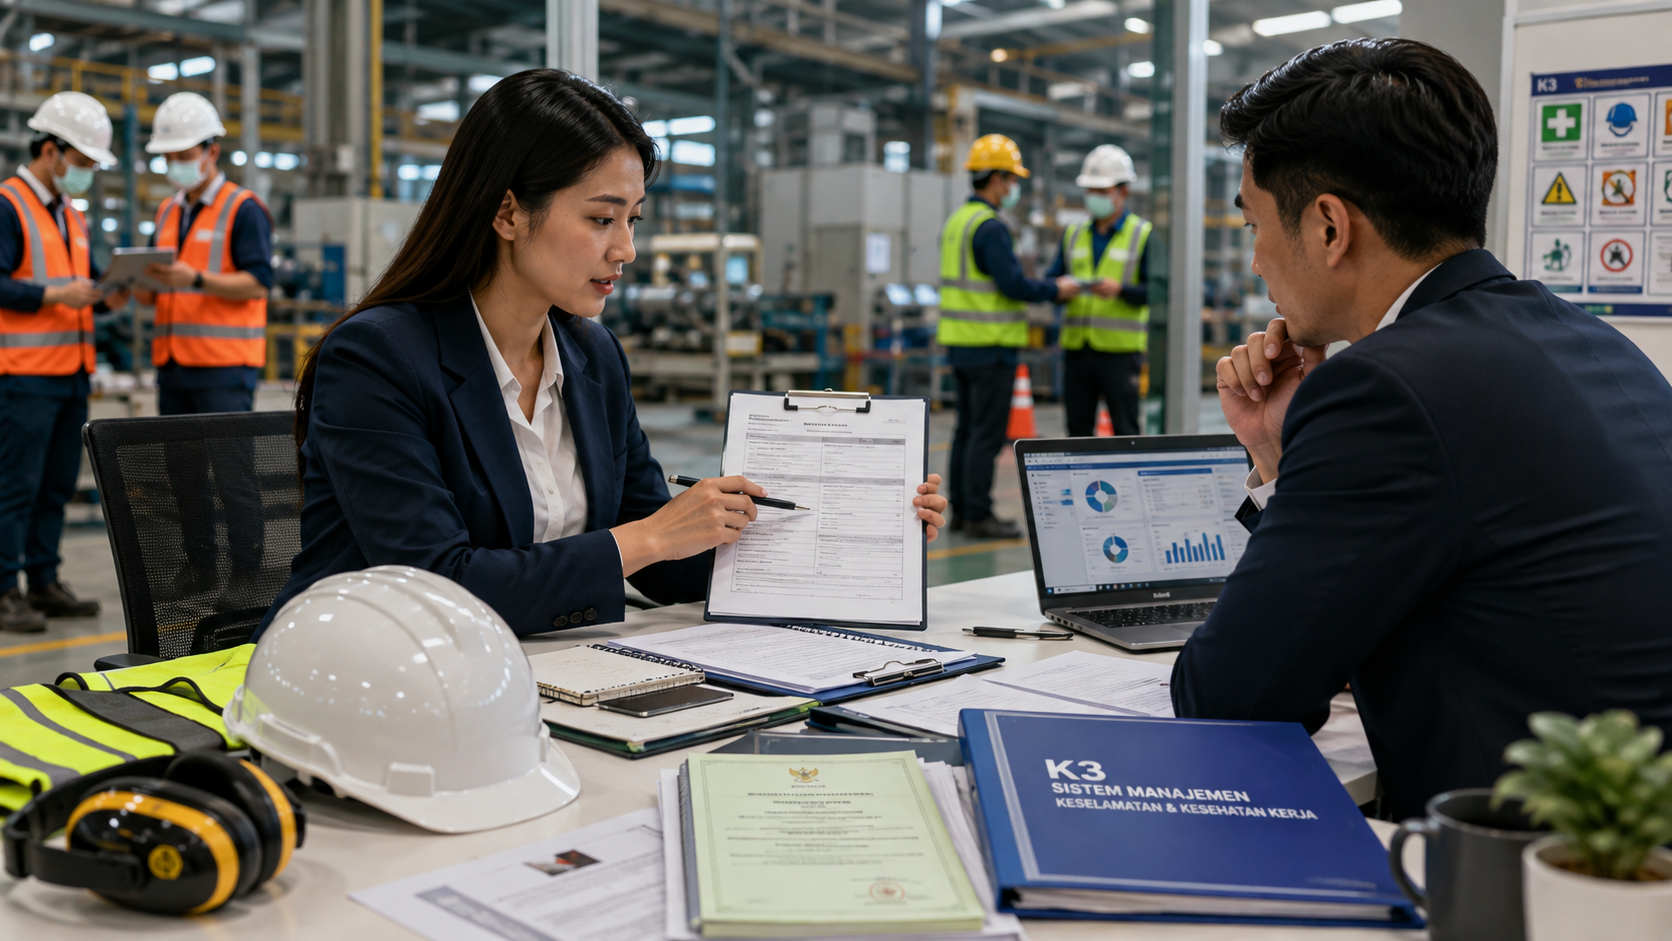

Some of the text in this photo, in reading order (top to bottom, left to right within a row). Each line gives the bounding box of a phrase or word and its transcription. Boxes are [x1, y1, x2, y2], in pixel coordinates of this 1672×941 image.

[1537, 78, 1557, 92] K3
[1045, 759, 1106, 781] K3
[1051, 782, 1250, 802] SISTEM MANAJEMEN
[1055, 798, 1318, 820] KESELAMATAN & KESEHATAN KERJA
